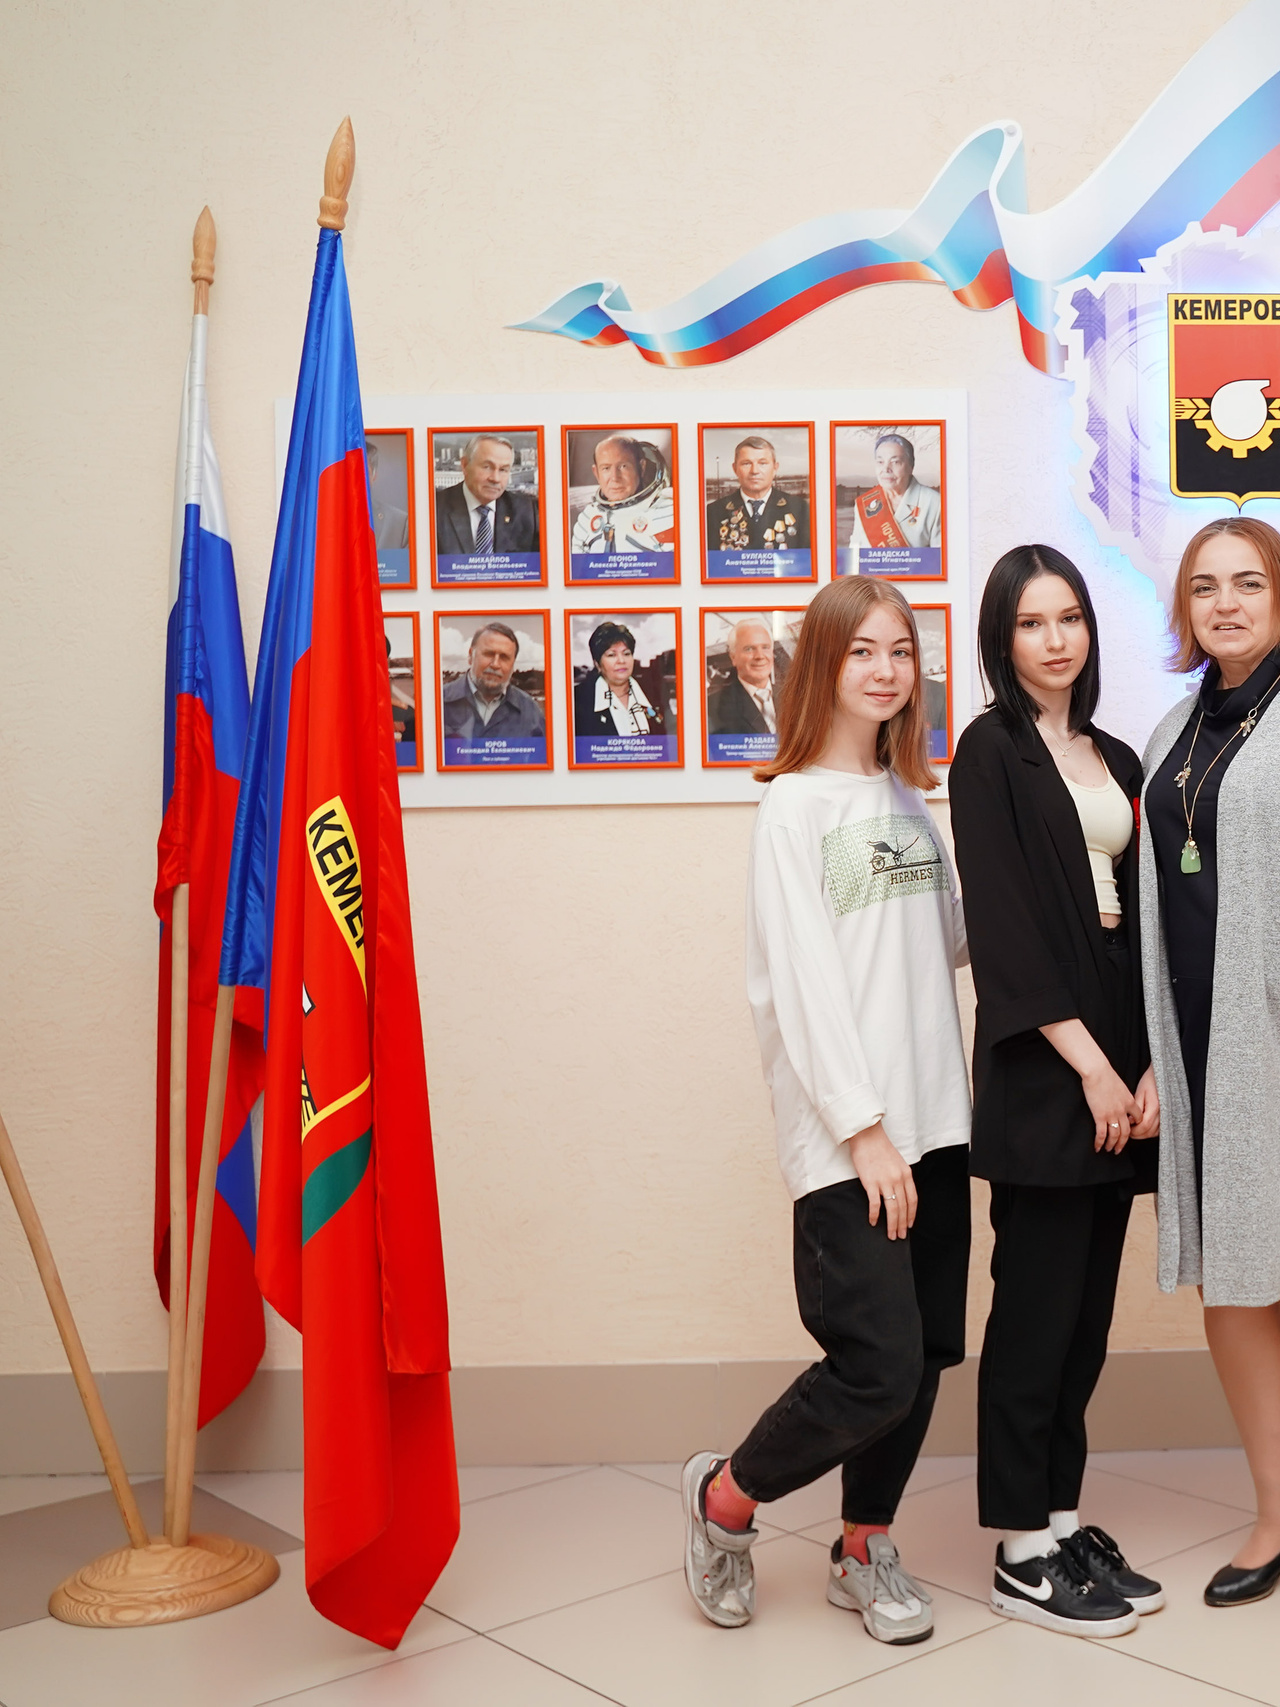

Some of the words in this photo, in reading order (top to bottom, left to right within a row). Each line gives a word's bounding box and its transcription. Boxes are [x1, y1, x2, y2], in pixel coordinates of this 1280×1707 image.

[868, 550, 910, 558] ЗАВАДСКАЯ
[468, 555, 511, 564] МИХАЙЛОВ
[452, 563, 486, 571] Владимир
[488, 562, 528, 570] Васильевич
[589, 561, 618, 569] Алексей
[619, 561, 657, 569] Архипович
[485, 740, 507, 748] ЮРОВ
[607, 738, 646, 746] КОРЯКОВА
[308, 808, 364, 949] КЕМЕ
[890, 867, 934, 885] HERMES
